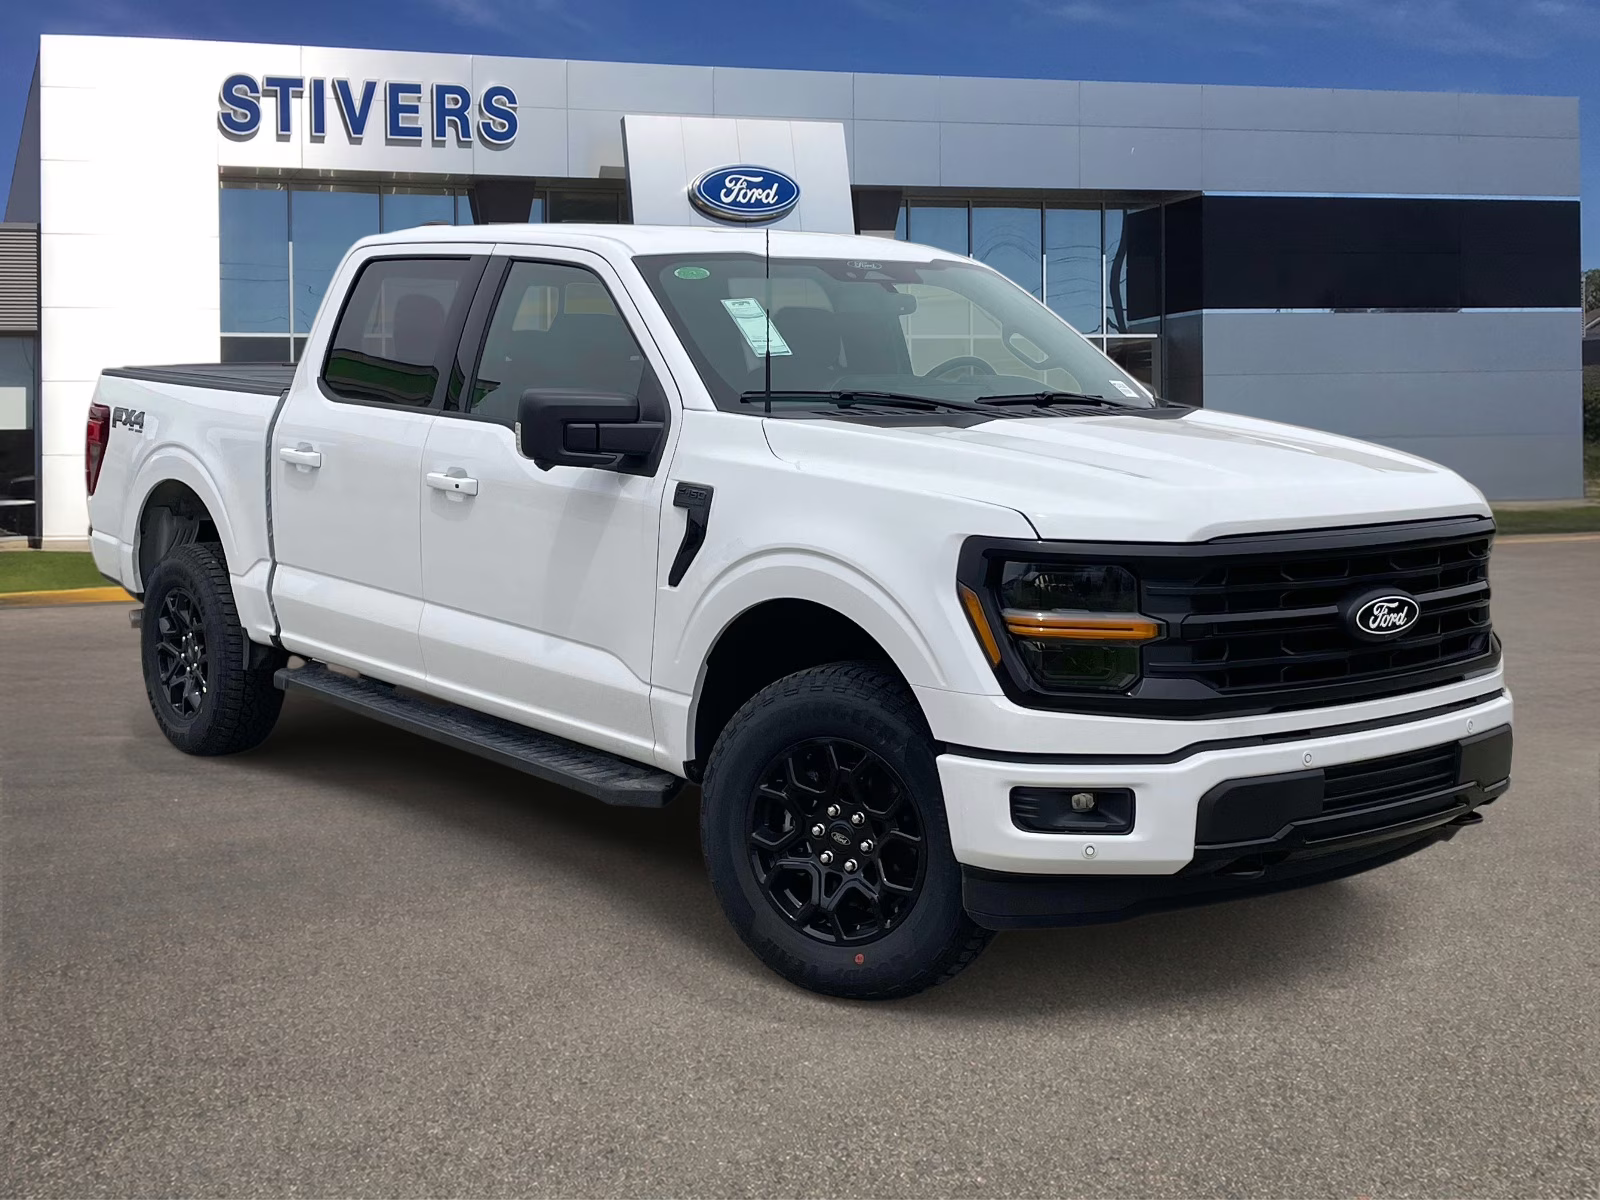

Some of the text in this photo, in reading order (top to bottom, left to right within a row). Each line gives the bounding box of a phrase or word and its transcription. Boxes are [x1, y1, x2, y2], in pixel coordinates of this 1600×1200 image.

[217, 73, 519, 144] STIVERS
[720, 174, 779, 204] Ford
[111, 406, 146, 429] FX4
[1368, 601, 1409, 629] Ford
